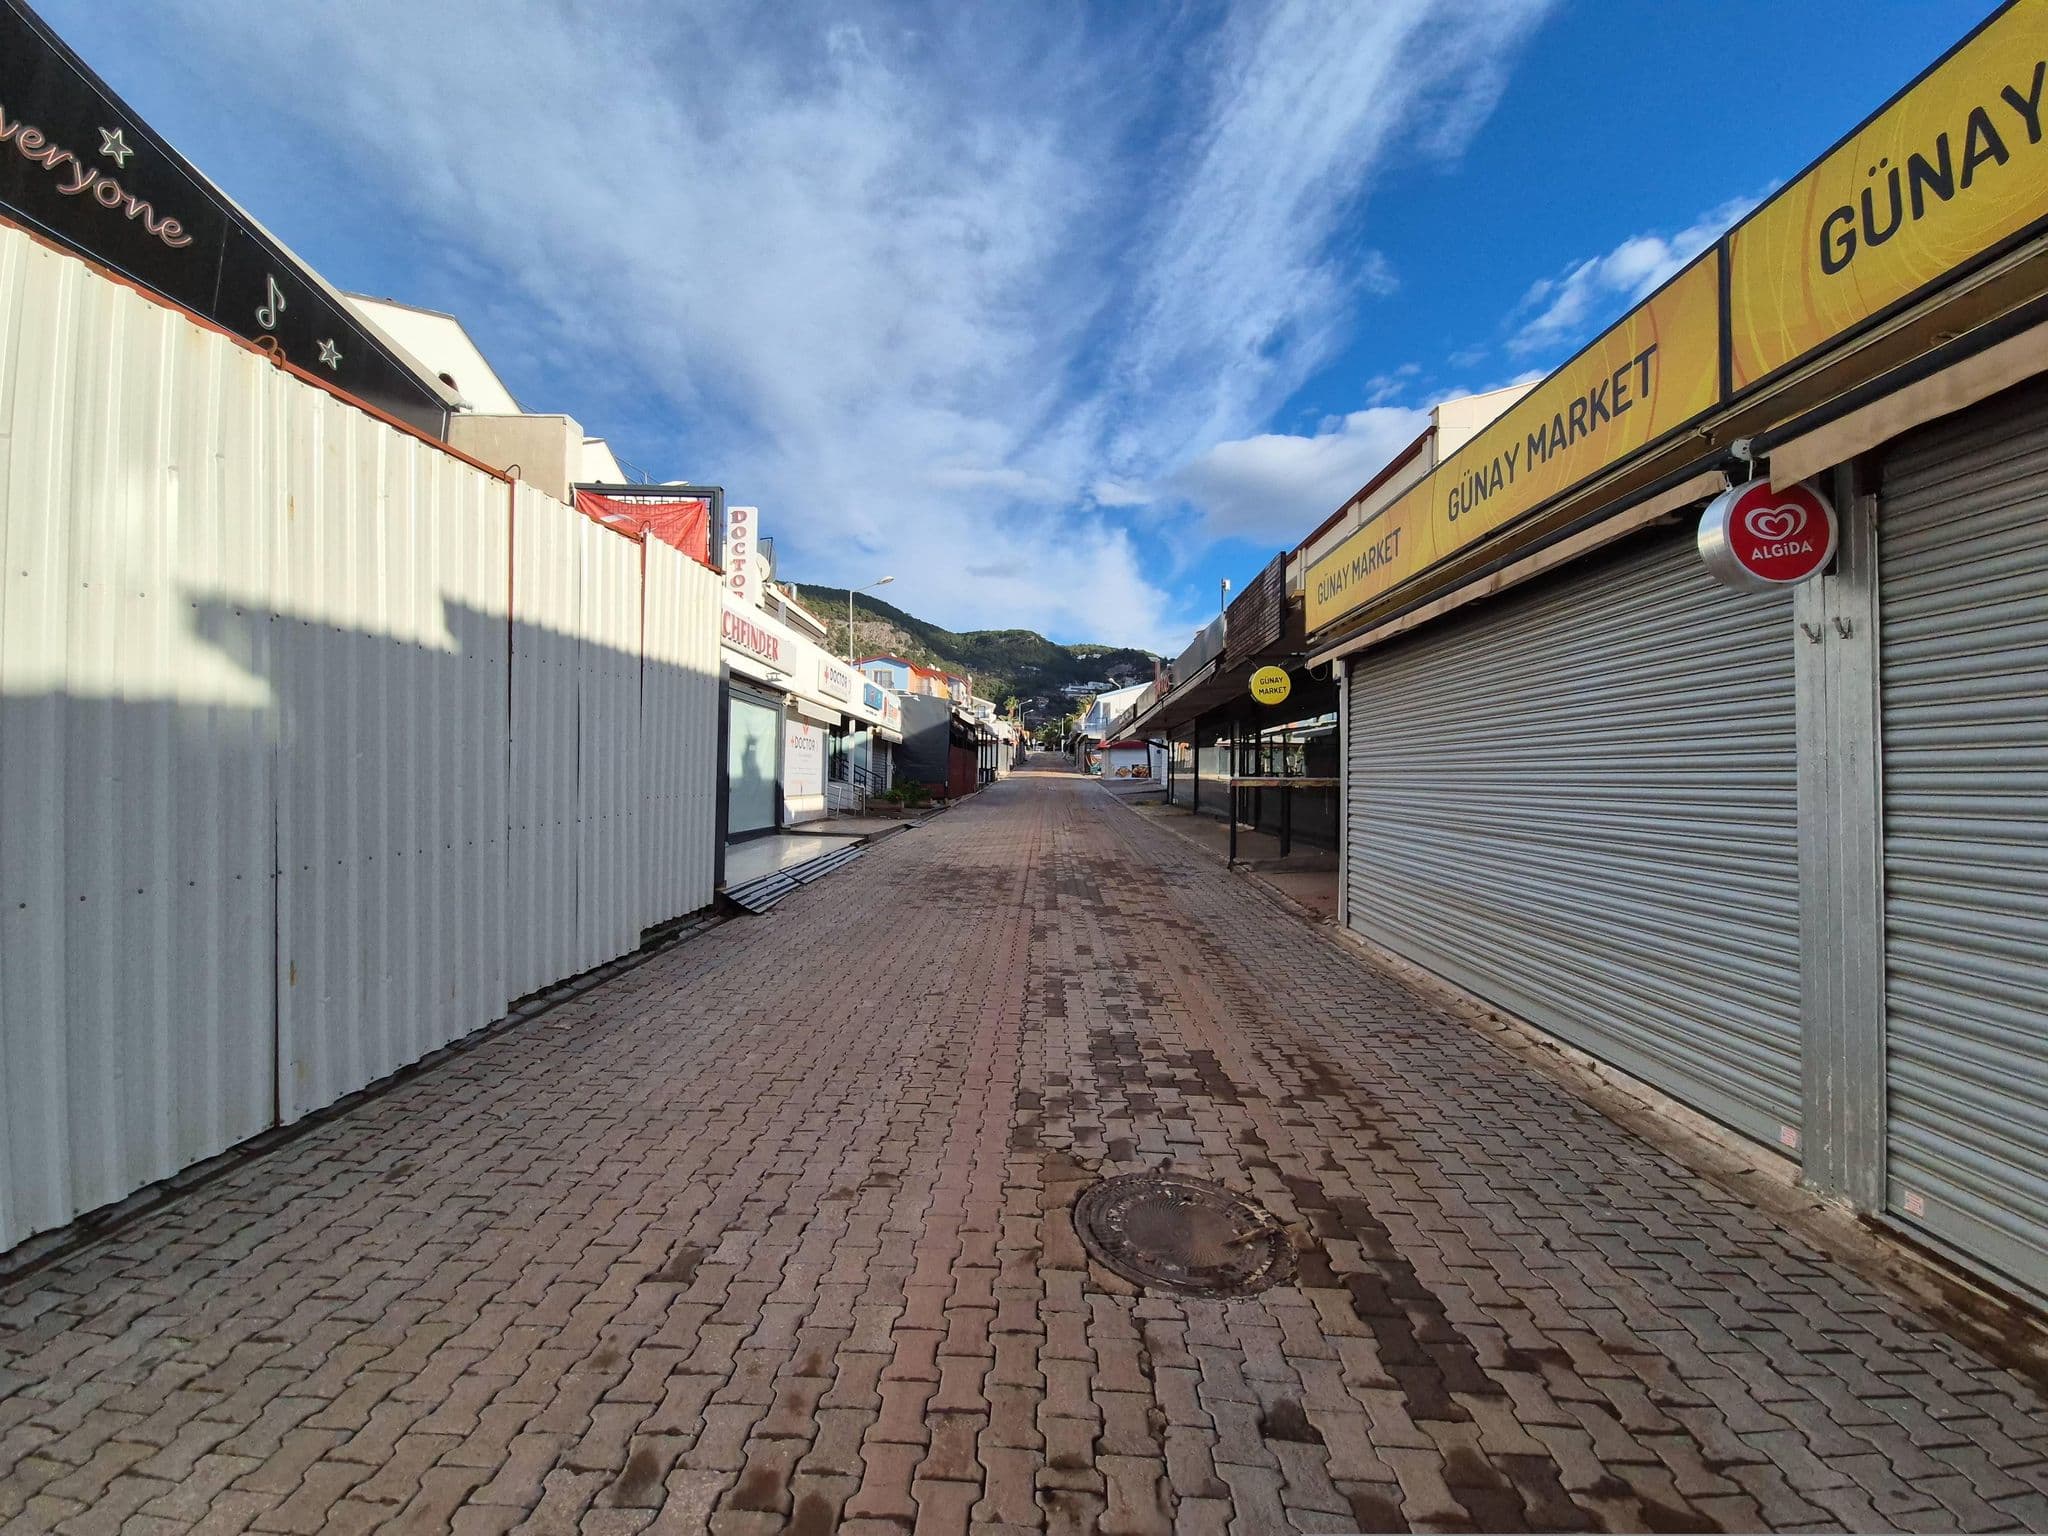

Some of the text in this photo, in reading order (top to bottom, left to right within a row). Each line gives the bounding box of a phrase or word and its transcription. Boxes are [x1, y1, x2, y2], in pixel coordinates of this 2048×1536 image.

[1819, 60, 2047, 275] GÜNAY
[1448, 342, 1658, 522] GÜNAY MARKET
[1317, 526, 1401, 605] GÜNAY MARKET
[721, 607, 778, 661] CHFINDER
[794, 735, 815, 752] DOCTOR
